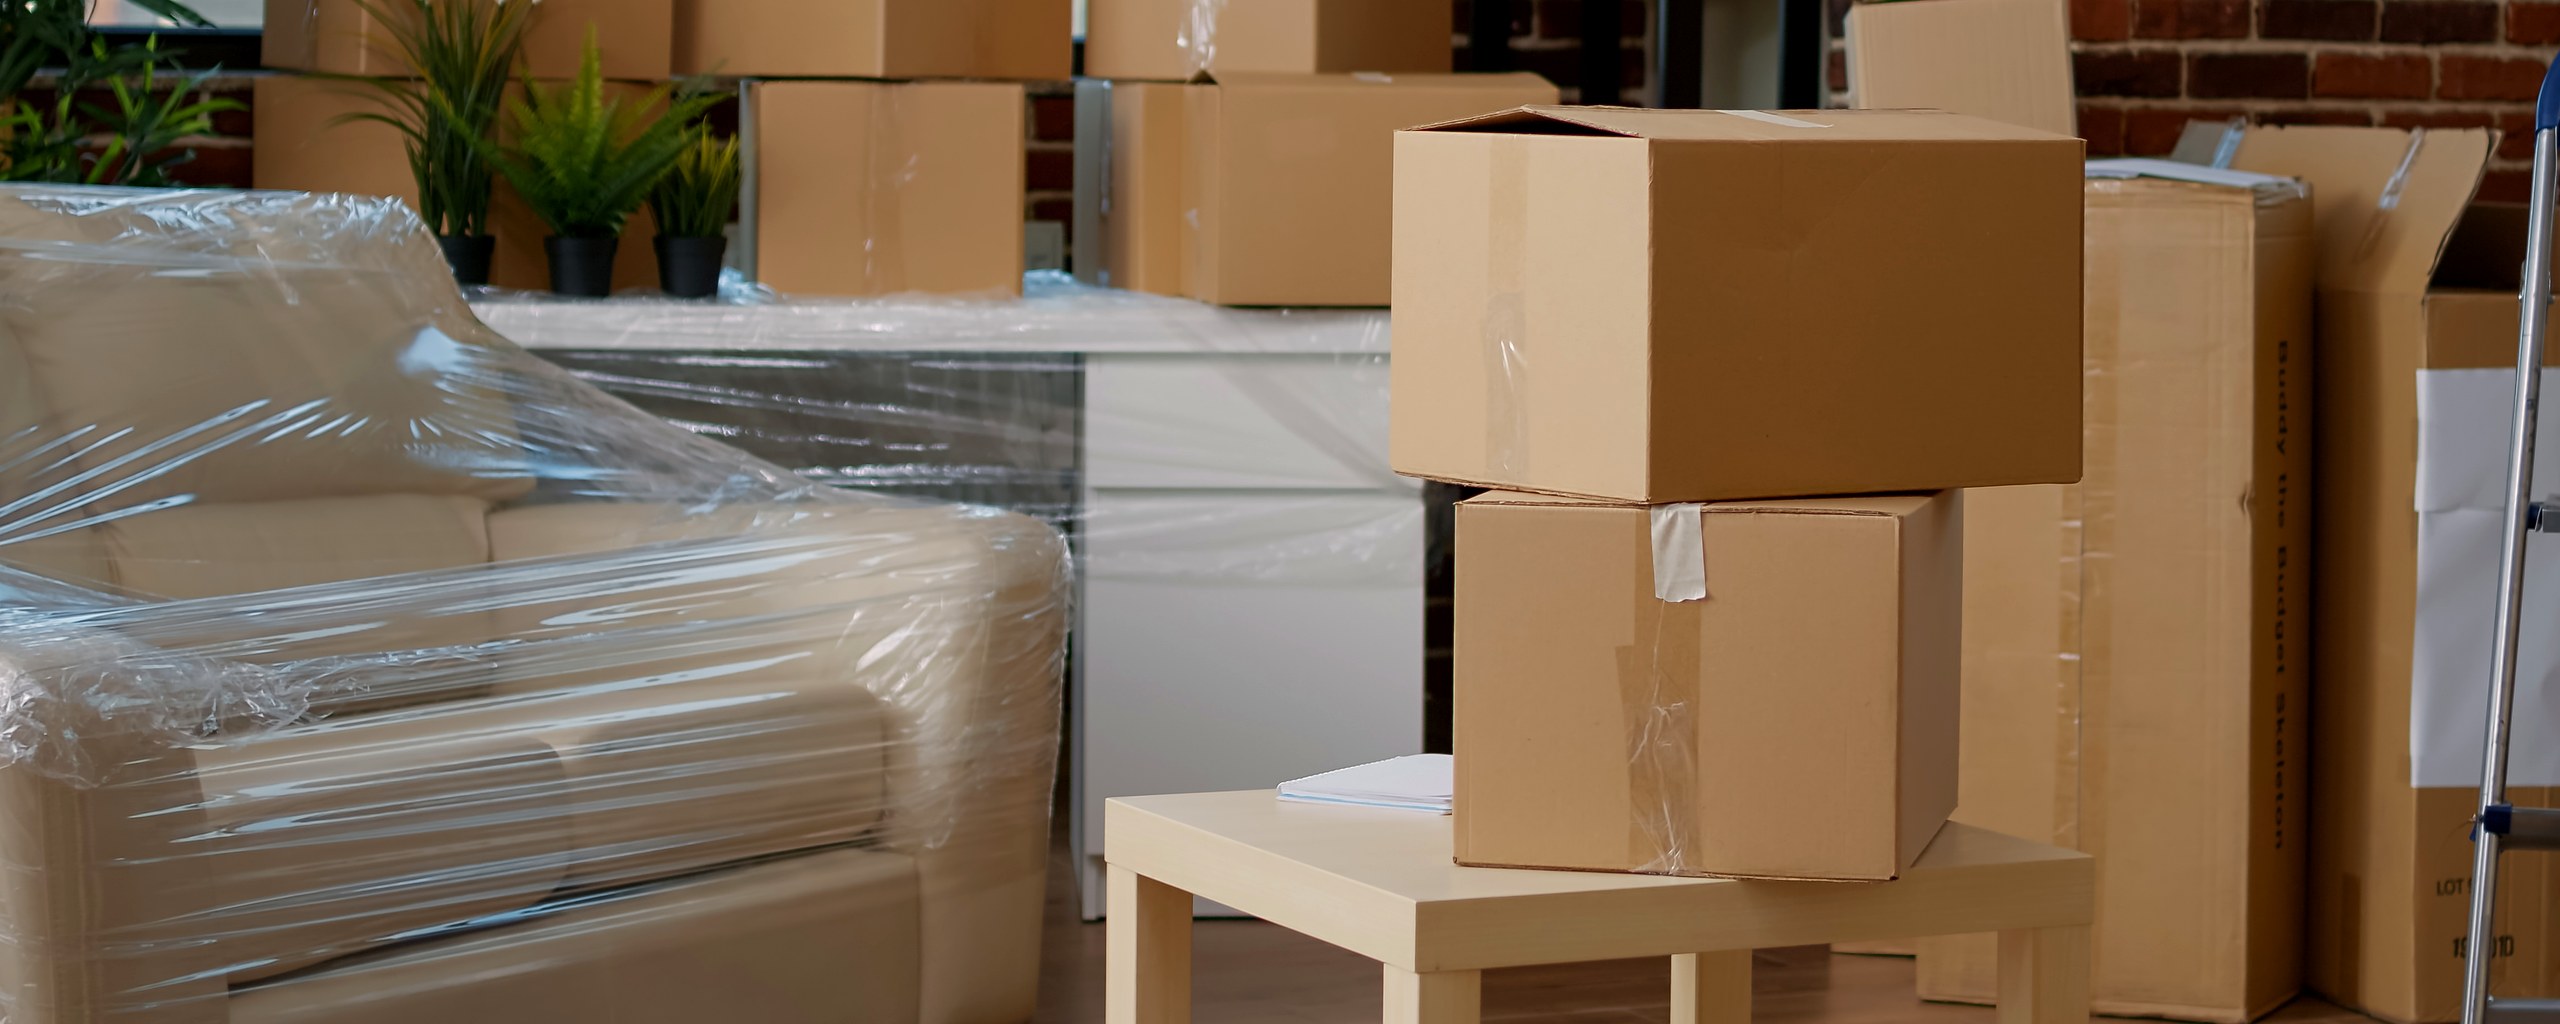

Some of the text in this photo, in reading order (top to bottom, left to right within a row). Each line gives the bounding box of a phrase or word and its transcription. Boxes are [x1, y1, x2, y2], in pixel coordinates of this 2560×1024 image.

[2275, 340, 2288, 849] Buddy the Budget Skeleton
[2436, 878, 2464, 896] LOT
